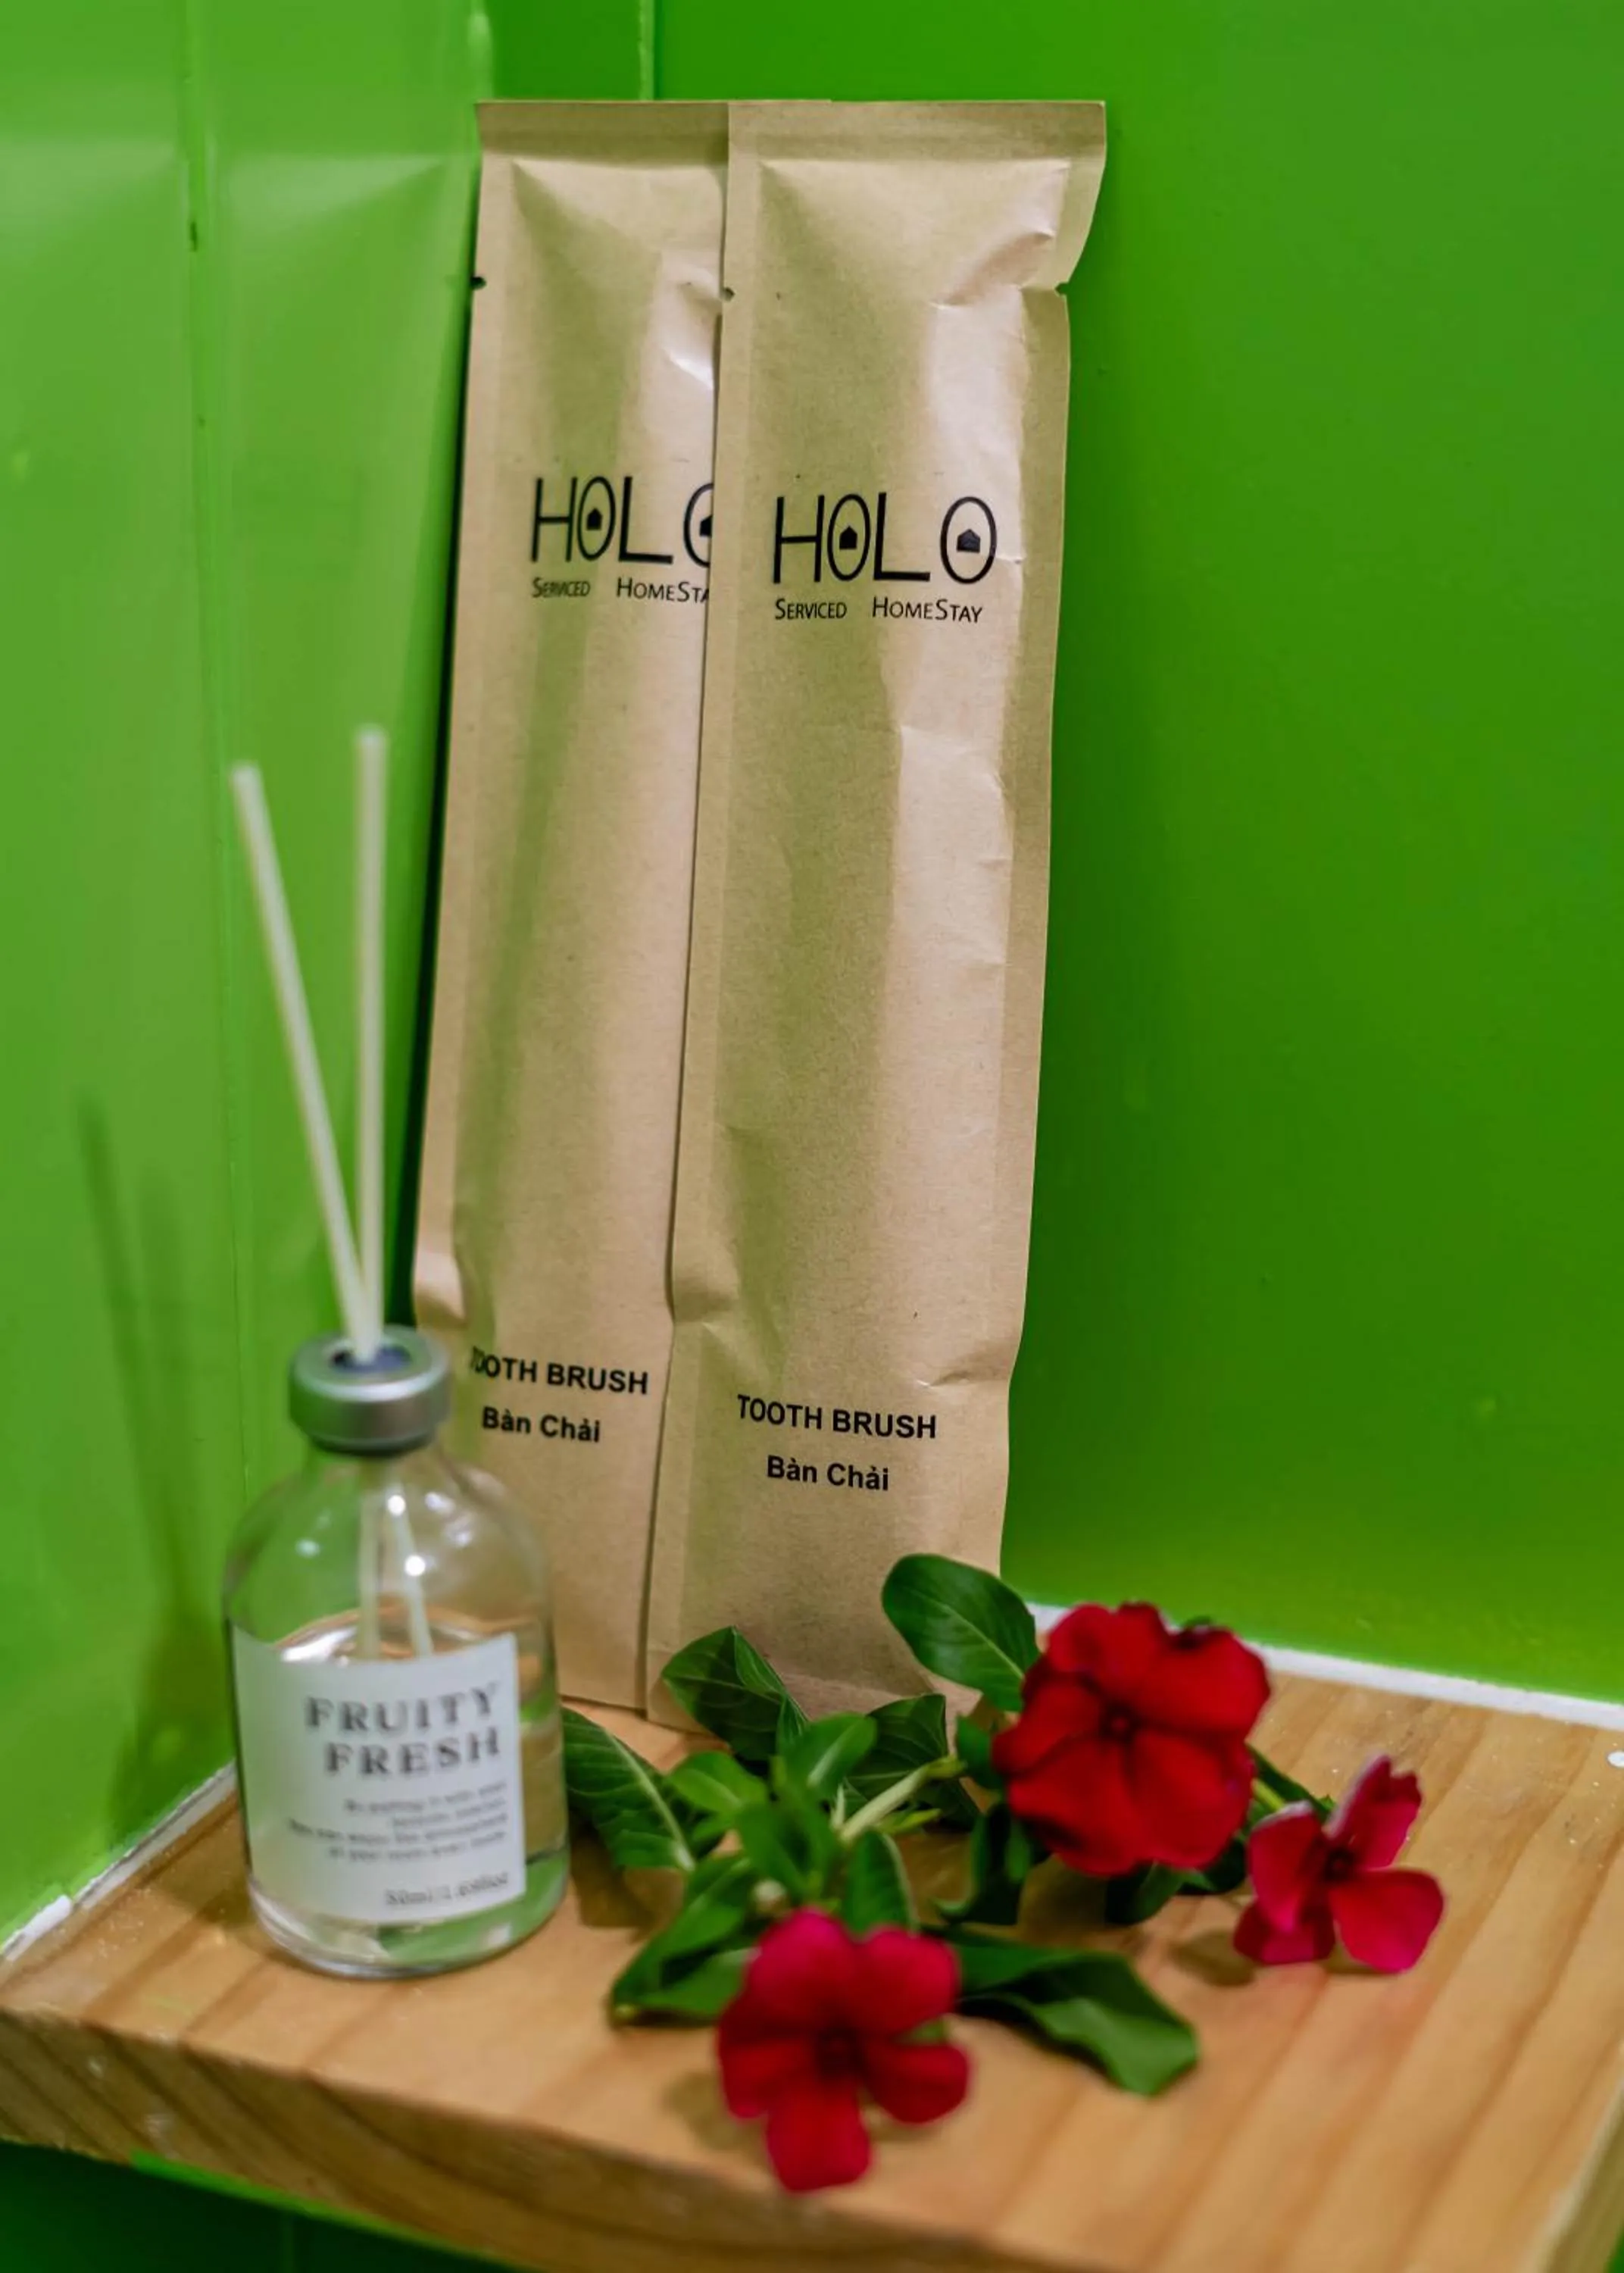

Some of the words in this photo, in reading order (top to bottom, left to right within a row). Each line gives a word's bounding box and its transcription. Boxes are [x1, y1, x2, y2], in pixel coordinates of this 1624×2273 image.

[773, 492, 997, 584] HOLO
[617, 577, 710, 605] HOMESTA
[547, 1362, 648, 1395] BRUSH
[482, 1406, 532, 1434] Bàn
[540, 1415, 601, 1443] Chải
[737, 1394, 823, 1430] TOOTH
[832, 1409, 937, 1439] BRUSH
[767, 1455, 818, 1483] Bàn
[826, 1462, 889, 1491] Chải
[304, 1681, 498, 1735] FRUITY
[326, 1726, 500, 1775] FRESH
